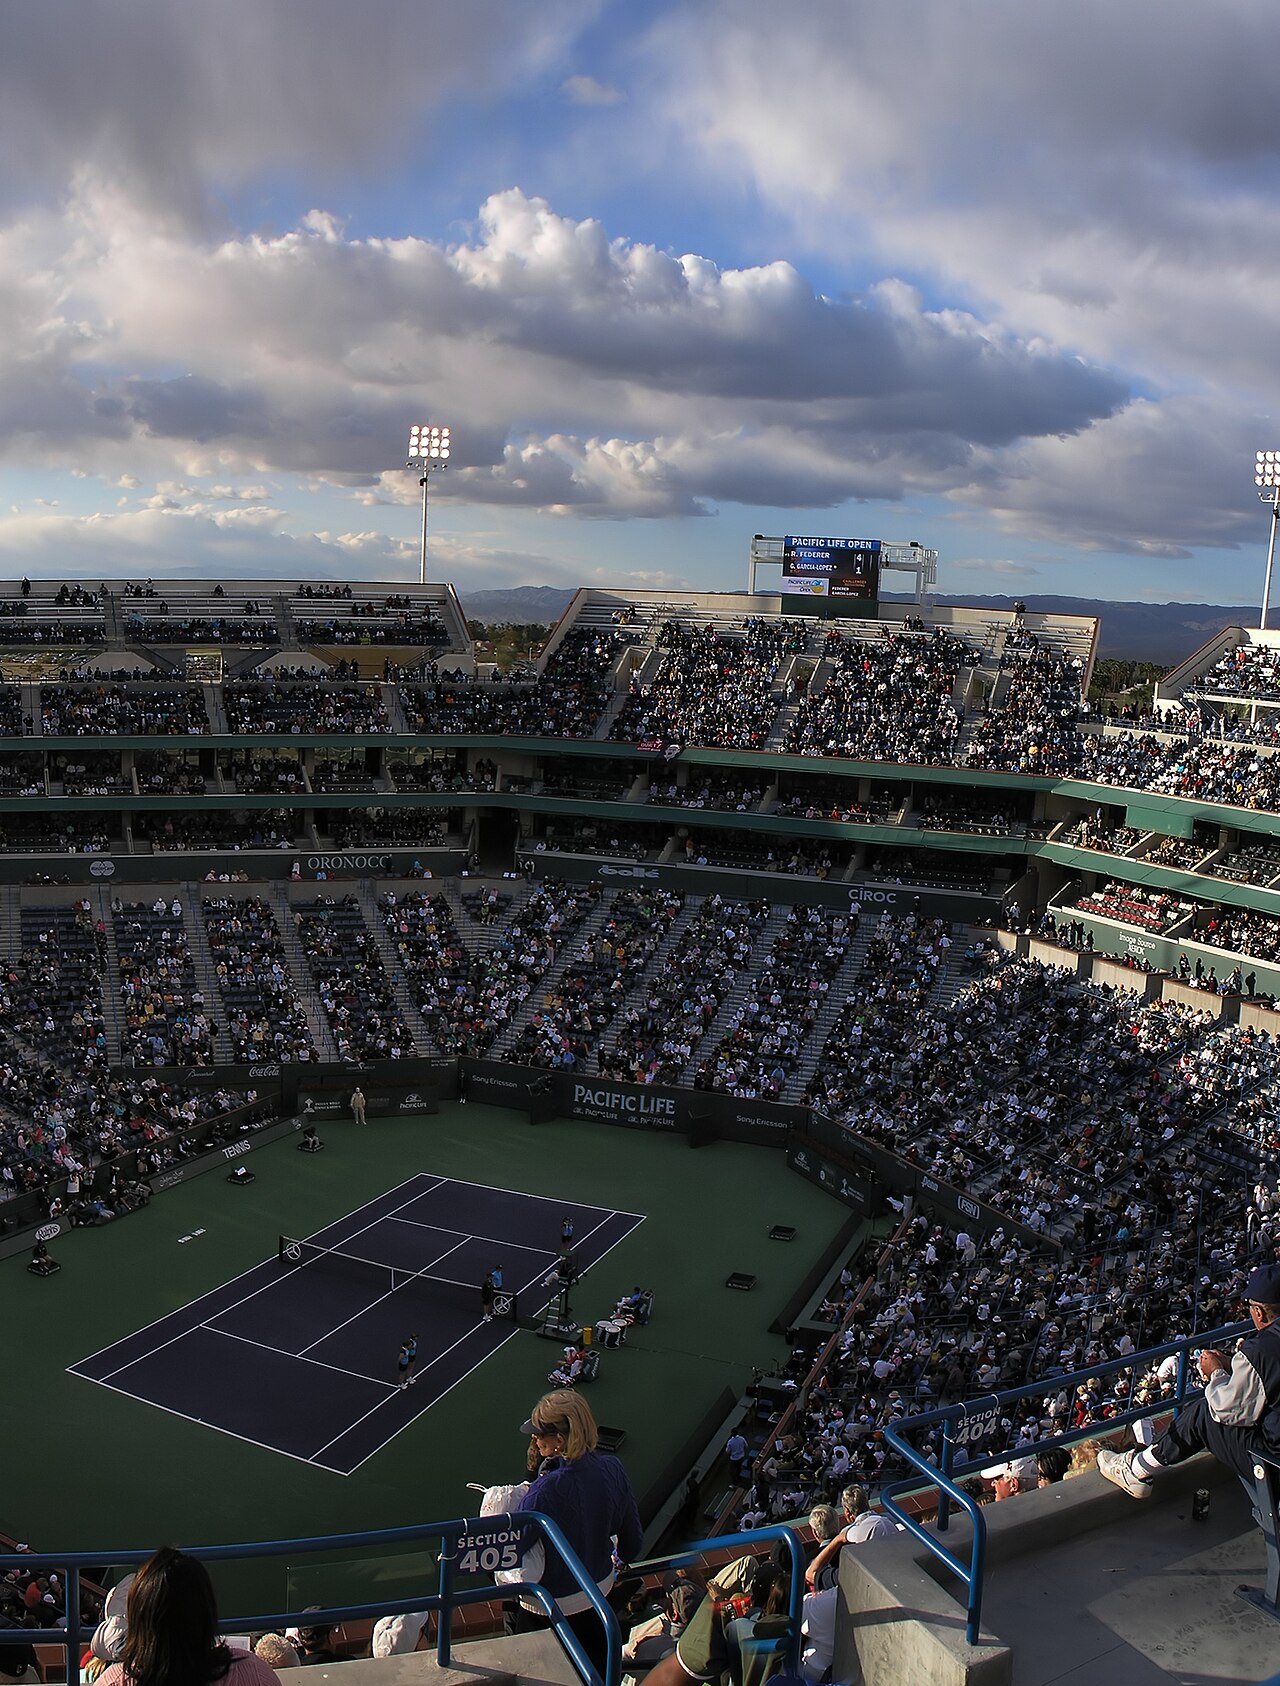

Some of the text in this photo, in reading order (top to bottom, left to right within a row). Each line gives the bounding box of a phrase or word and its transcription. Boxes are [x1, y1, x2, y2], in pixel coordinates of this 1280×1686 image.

[791, 538, 872, 549] PACIFIC LIFE OPEN
[800, 551, 830, 559] FEDERER
[856, 553, 862, 562] 4
[797, 563, 833, 571] GARCIA-LOPEZ
[1119, 931, 1136, 945] Image
[472, 1074, 517, 1088] Sony Ericsson
[573, 1084, 675, 1115] PACIFIC LIFE
[736, 1114, 788, 1129] Sony Ericsson
[222, 1139, 252, 1159] TENNIS
[957, 1406, 1001, 1429] SECTION
[956, 1417, 997, 1444] 404
[458, 1530, 521, 1549] SECTION
[460, 1544, 518, 1572] 405
